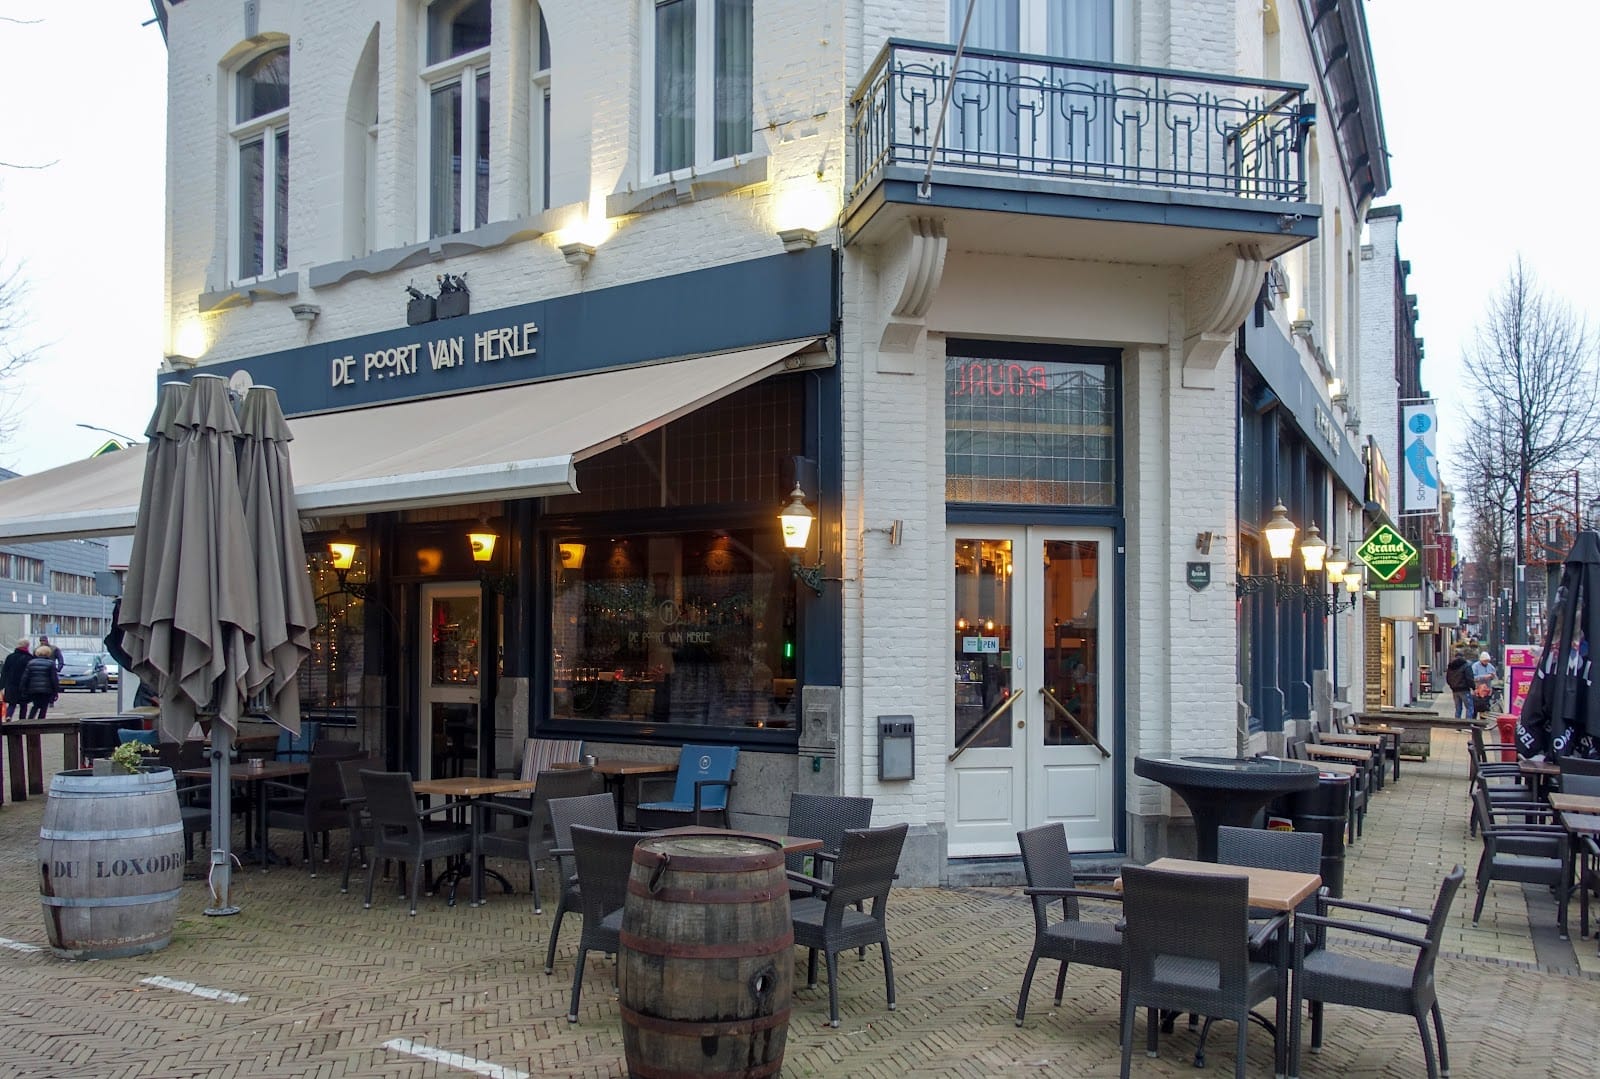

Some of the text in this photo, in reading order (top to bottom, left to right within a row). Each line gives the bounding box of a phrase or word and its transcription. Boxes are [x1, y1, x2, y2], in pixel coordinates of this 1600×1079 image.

[331, 322, 538, 387] DE POORT VAN HERLE
[1367, 541, 1405, 554] Brand
[54, 861, 80, 878] DU
